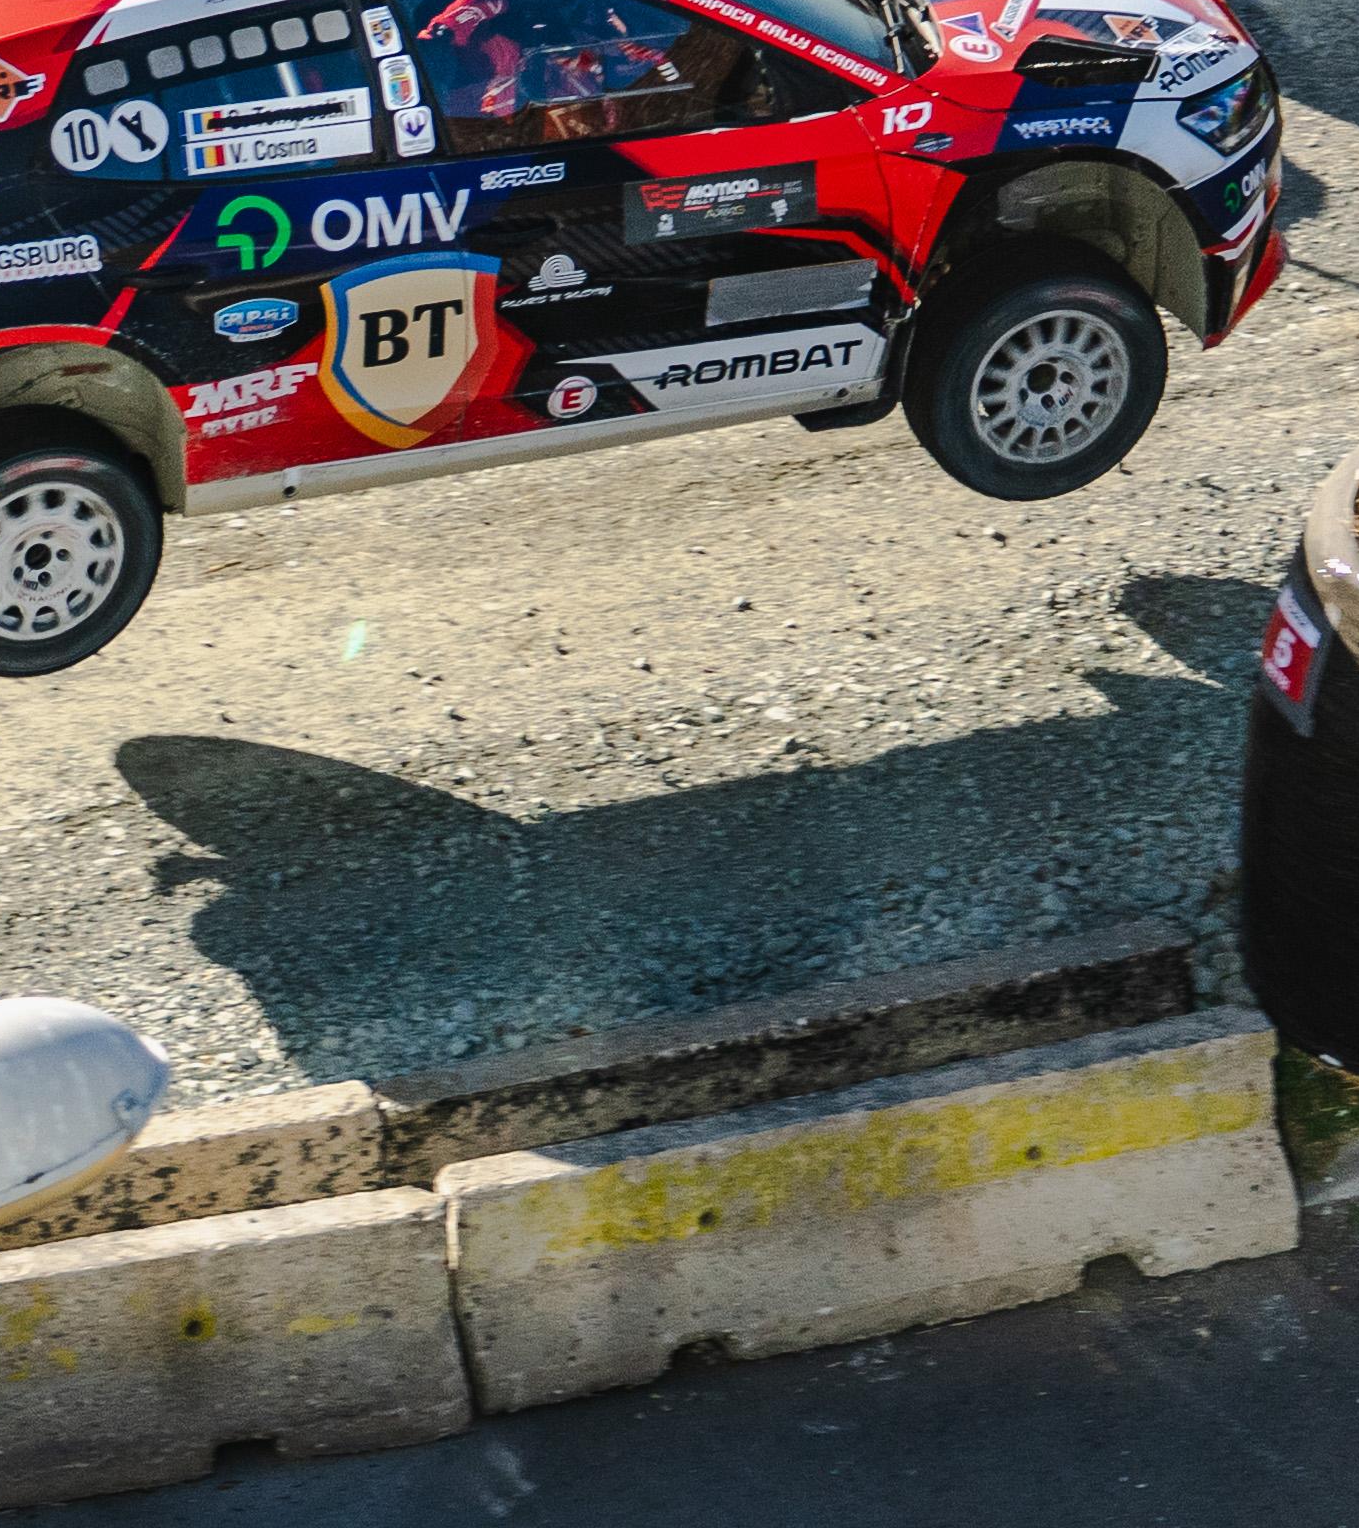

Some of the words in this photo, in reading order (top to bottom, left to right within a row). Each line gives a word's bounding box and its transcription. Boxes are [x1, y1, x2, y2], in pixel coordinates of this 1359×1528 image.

[757, 20, 812, 50] RALLY
[810, 45, 889, 88] ACADEMY
[62, 118, 100, 163] 10
[230, 143, 248, 165] V.
[254, 136, 318, 162] Cosma
[311, 188, 470, 252] OMV
[359, 298, 464, 368] BT
[184, 361, 319, 418] MRF
[653, 339, 862, 390] ROMBAT
[561, 388, 583, 410] E
